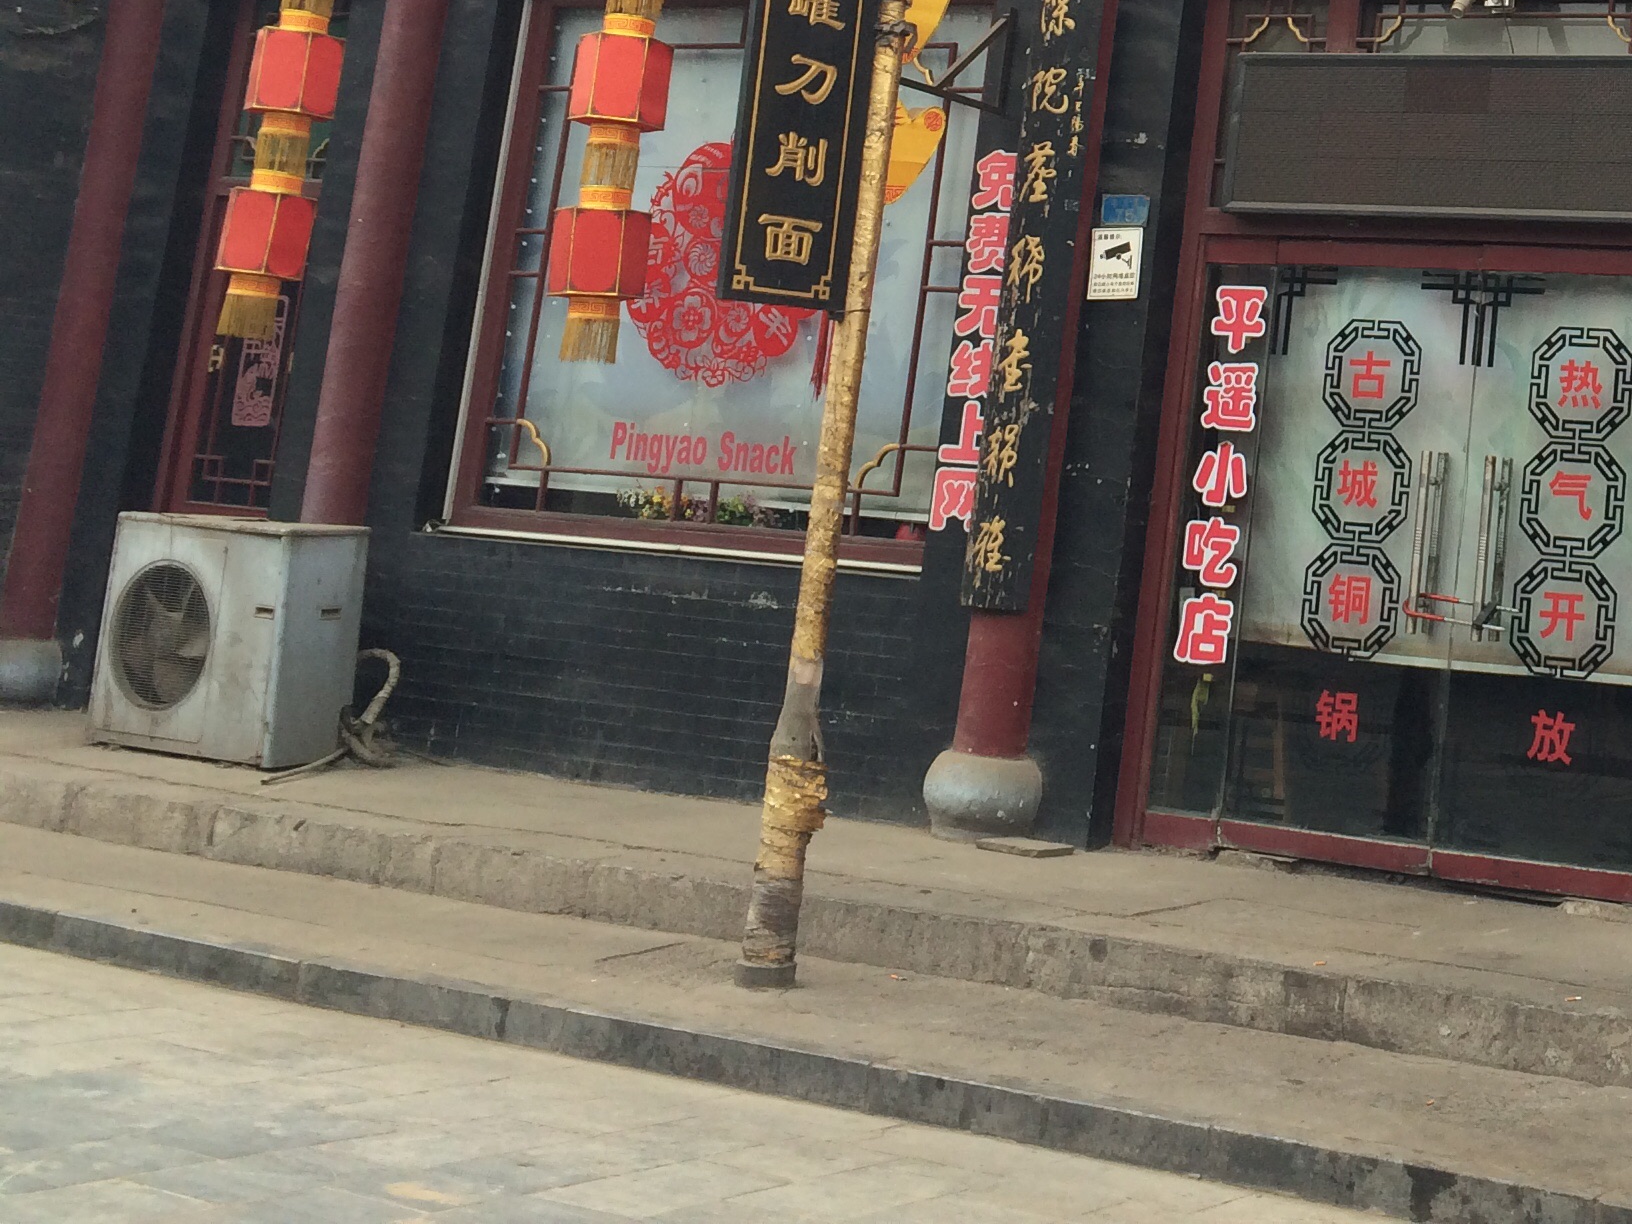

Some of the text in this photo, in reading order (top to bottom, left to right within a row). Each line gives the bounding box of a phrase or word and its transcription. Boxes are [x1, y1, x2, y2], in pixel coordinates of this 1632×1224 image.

[609, 421, 797, 475] Pingyao Snack
[929, 149, 1018, 533] 免费无线上网
[1174, 285, 1268, 665] 平遥小吃店
[1315, 350, 1391, 744] 古城铜锅
[1526, 359, 1603, 766] 热气开放
